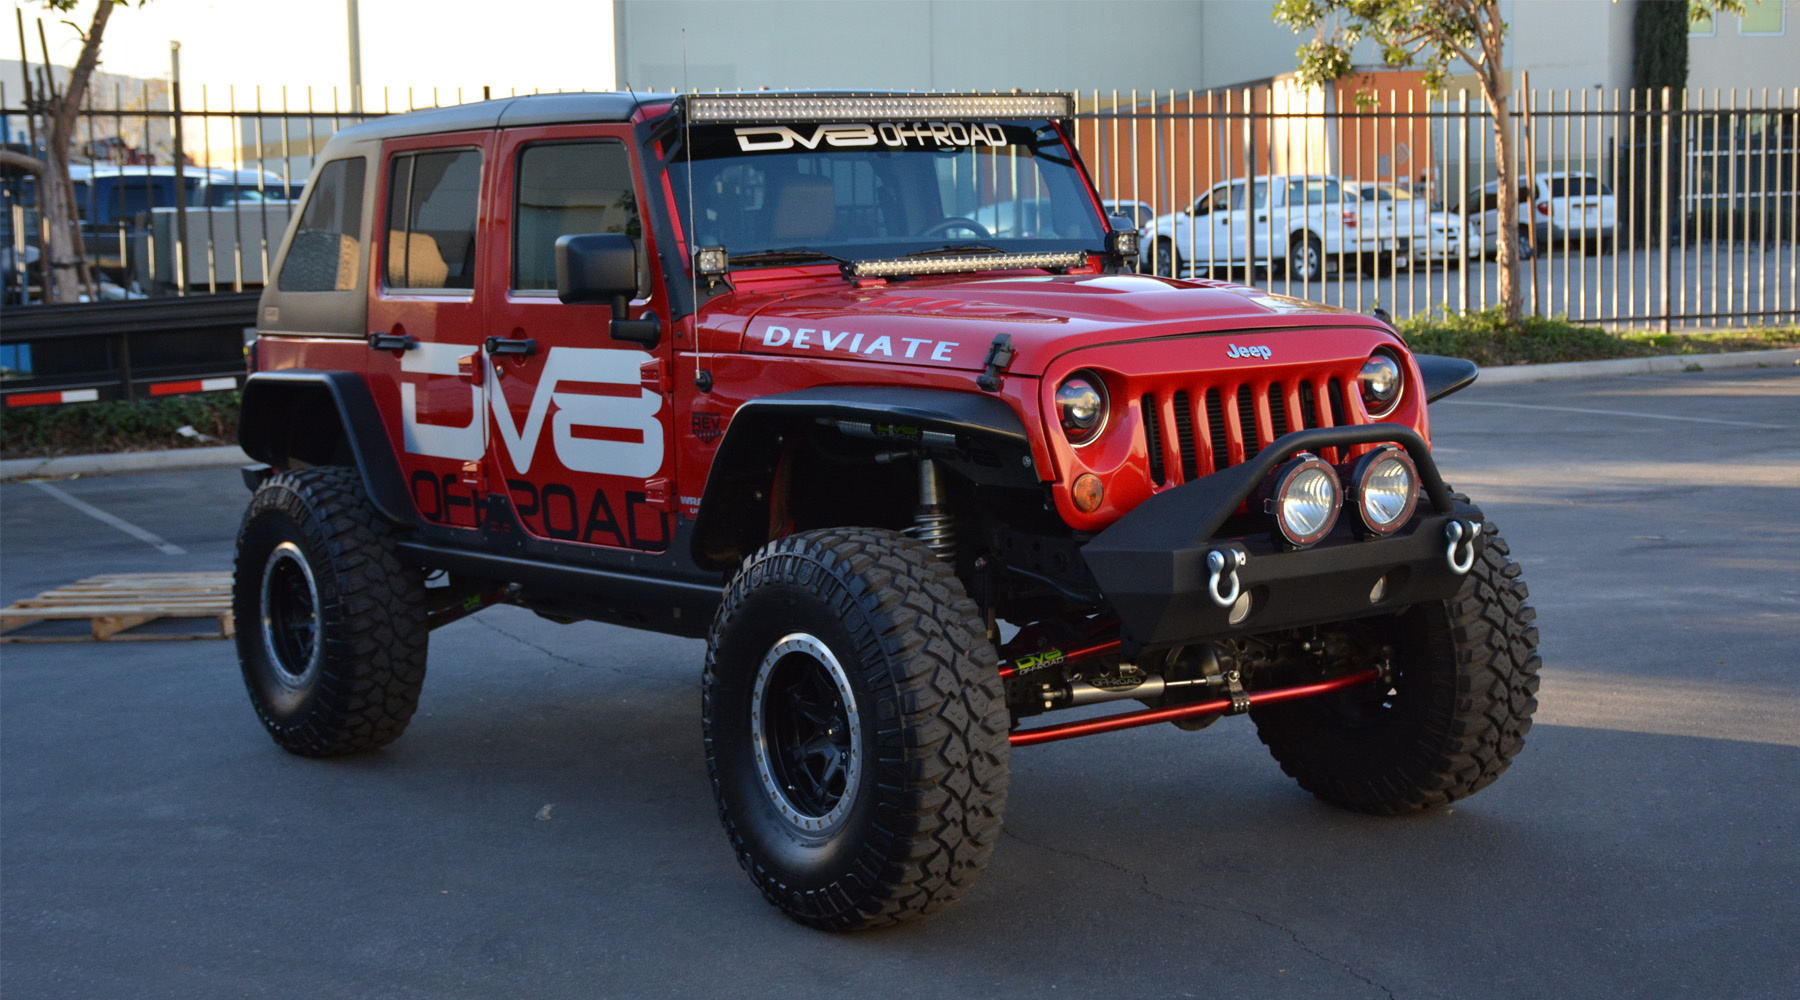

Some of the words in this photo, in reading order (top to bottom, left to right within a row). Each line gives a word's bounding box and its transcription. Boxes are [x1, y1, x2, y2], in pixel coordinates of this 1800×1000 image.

[733, 123, 878, 152] DV8
[762, 325, 960, 362] DEVIATE
[1226, 343, 1272, 360] Jeep
[400, 341, 665, 479] DV8
[692, 415, 721, 430] REV
[1015, 649, 1062, 670] DV8
